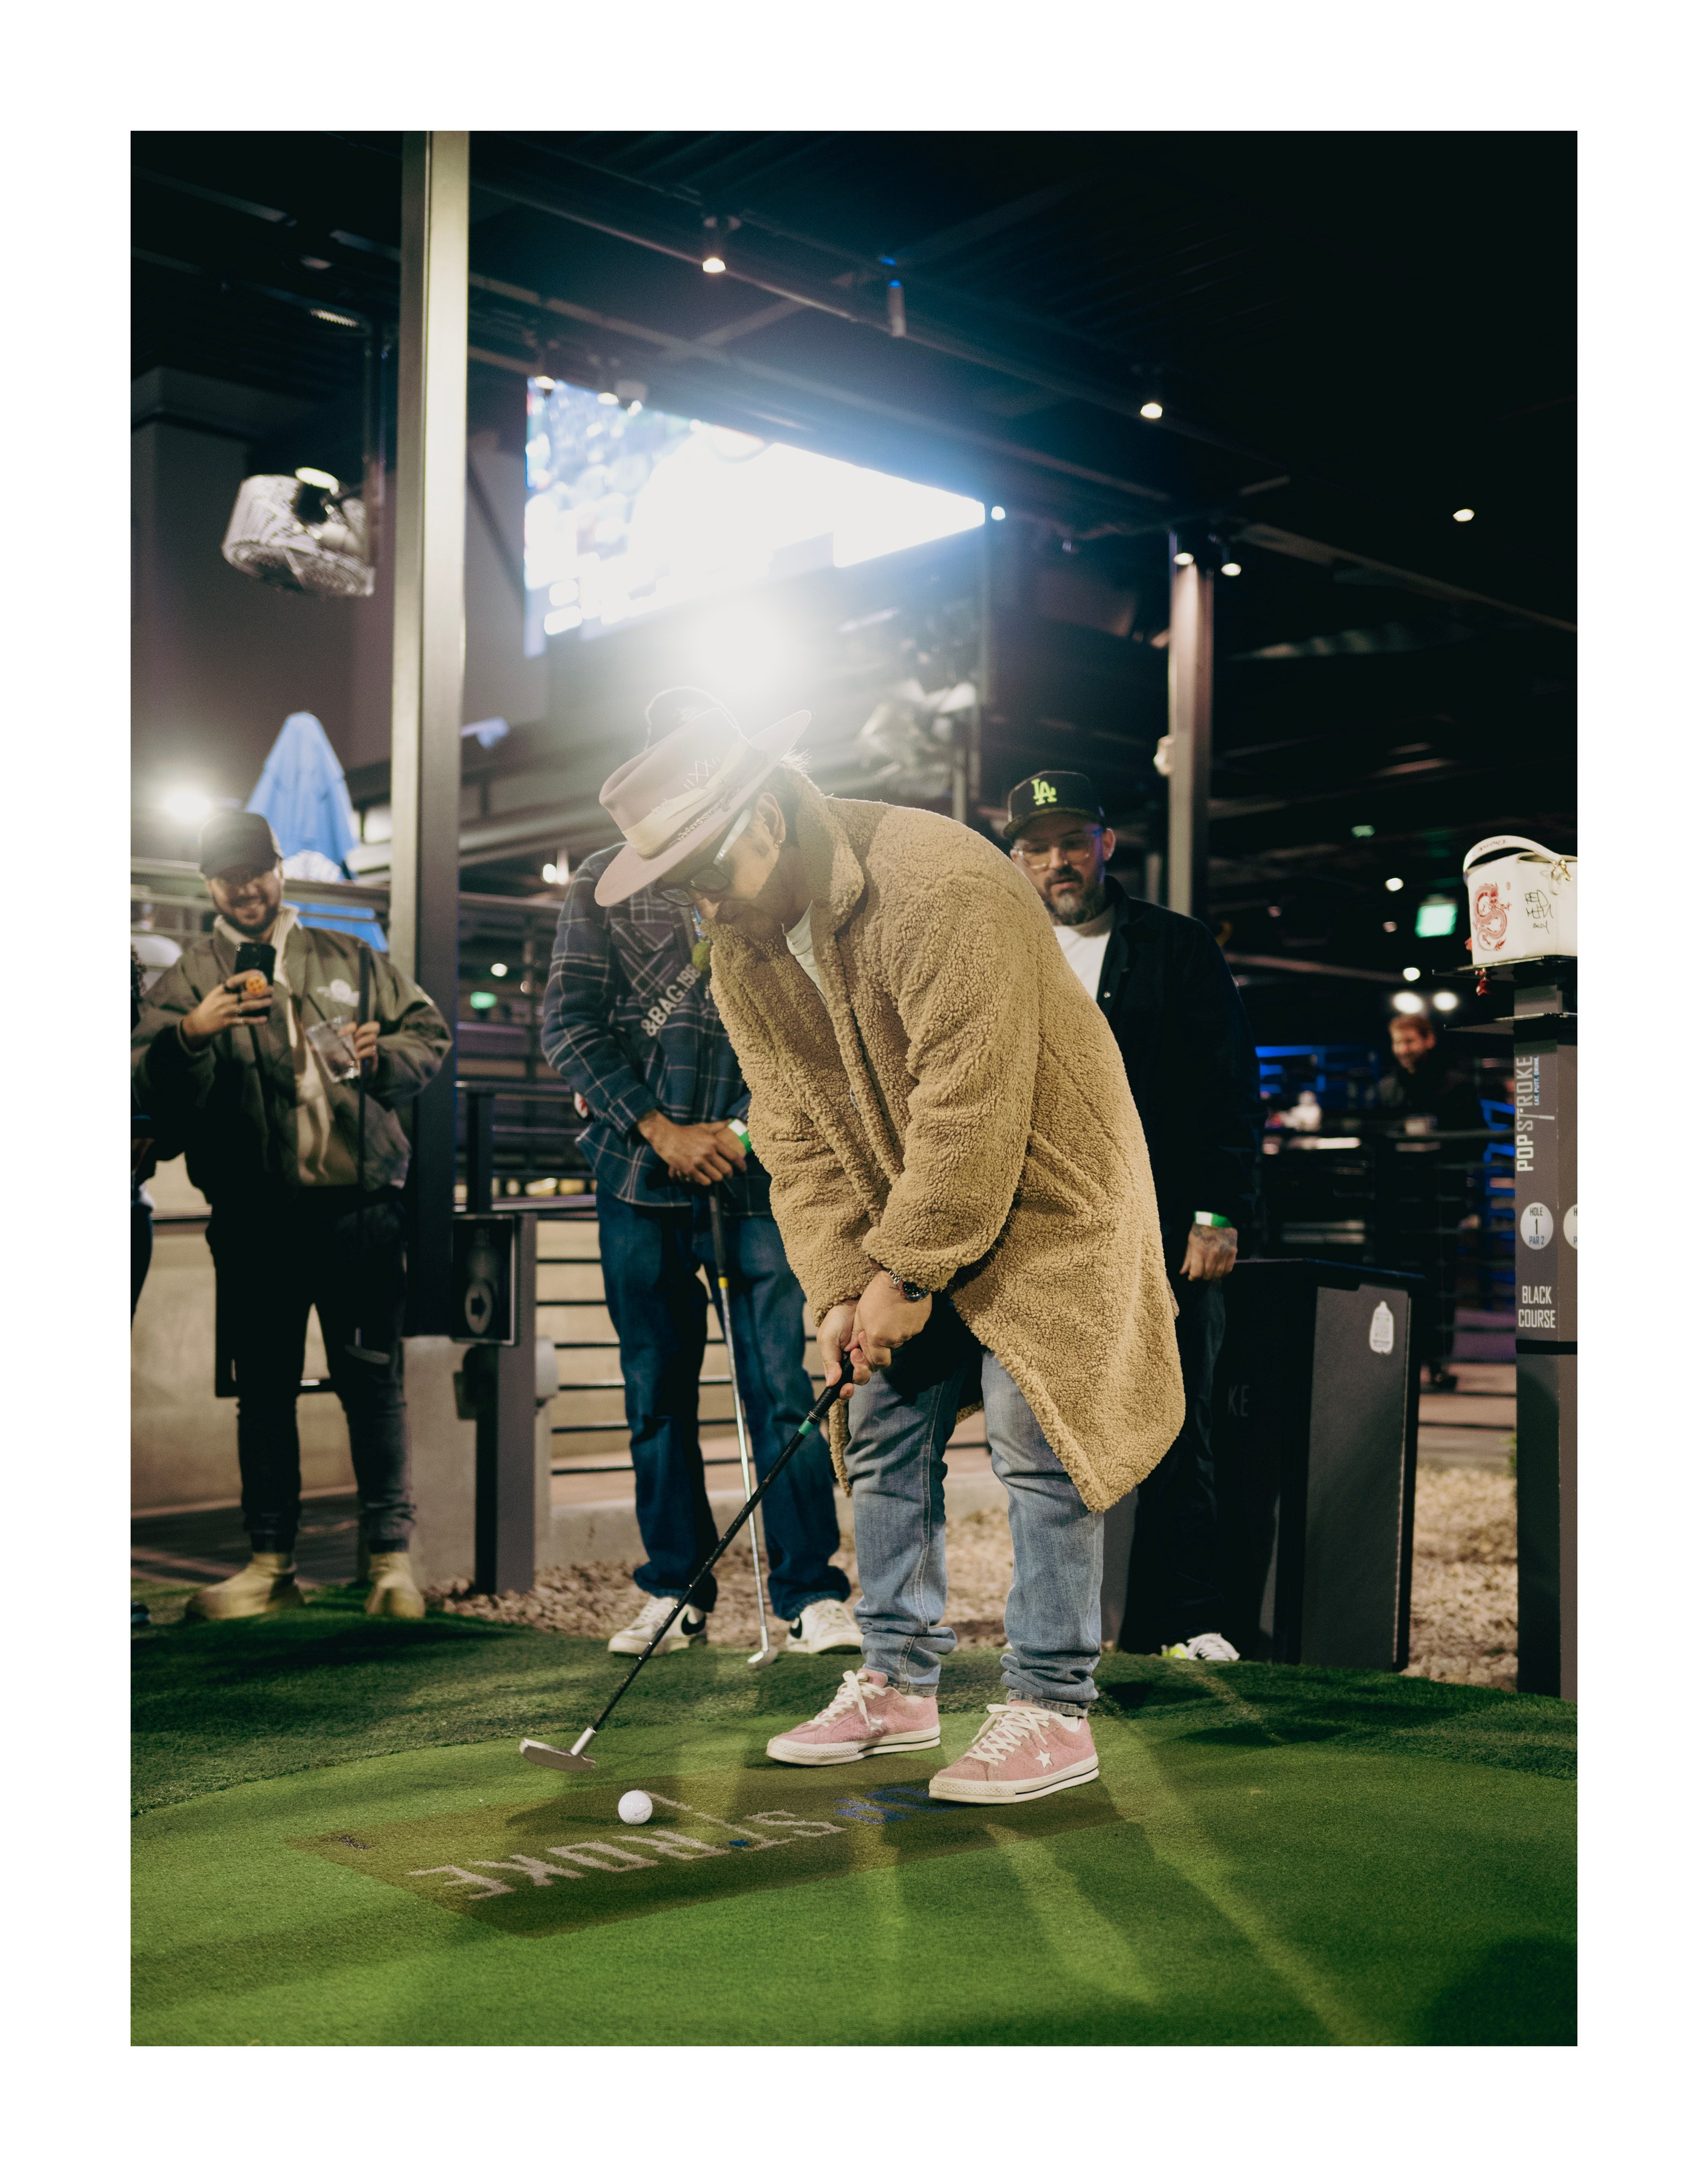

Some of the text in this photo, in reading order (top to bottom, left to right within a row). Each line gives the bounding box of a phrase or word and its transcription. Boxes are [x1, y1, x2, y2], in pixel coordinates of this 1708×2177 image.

[1031, 782, 1057, 806] LA
[1529, 1207, 1543, 1216] HOLE
[1535, 1218, 1538, 1235] 1
[1529, 1236, 1545, 1245] PAR 2
[1522, 1286, 1552, 1304] BLACK
[1519, 1309, 1555, 1328] COURSE
